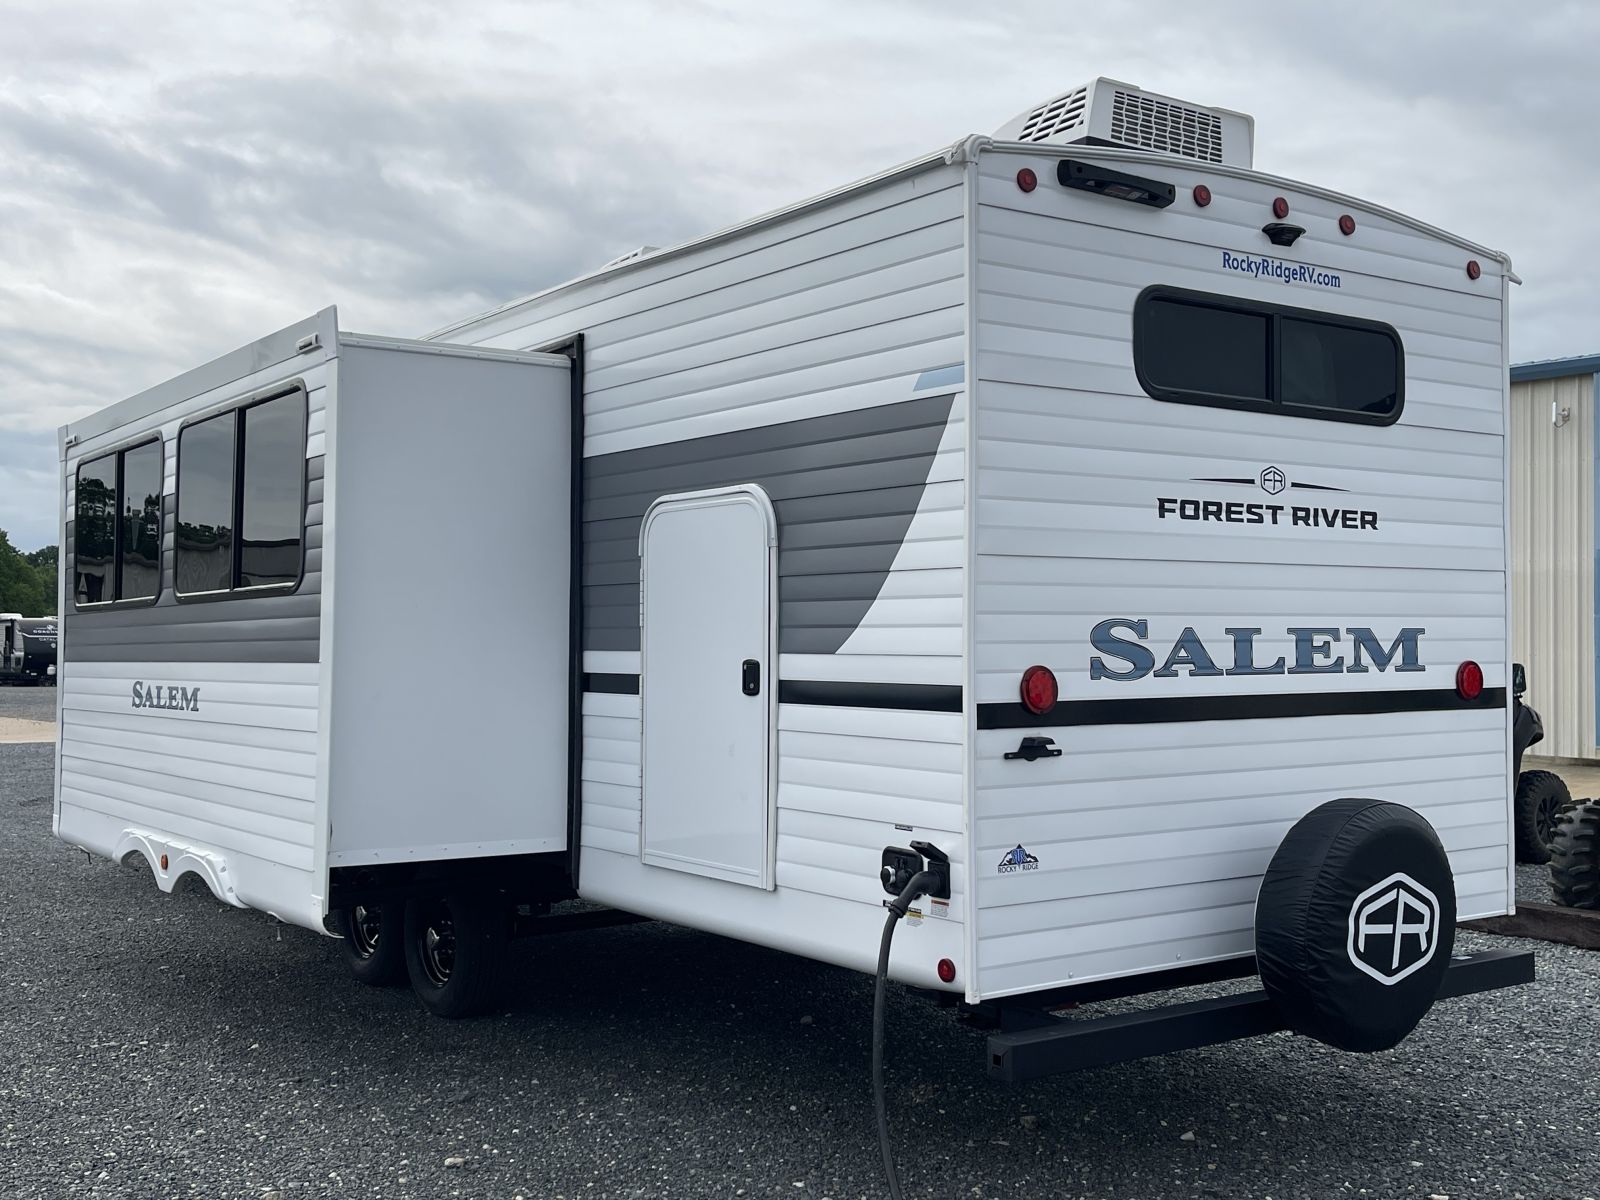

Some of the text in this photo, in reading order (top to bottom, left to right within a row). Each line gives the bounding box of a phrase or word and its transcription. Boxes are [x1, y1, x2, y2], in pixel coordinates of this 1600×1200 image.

[1222, 251, 1341, 288] RockyRidgeRV.com
[1156, 497, 1379, 530] FOREST RIVER
[998, 862, 1039, 874] ROCKY RIDGE
